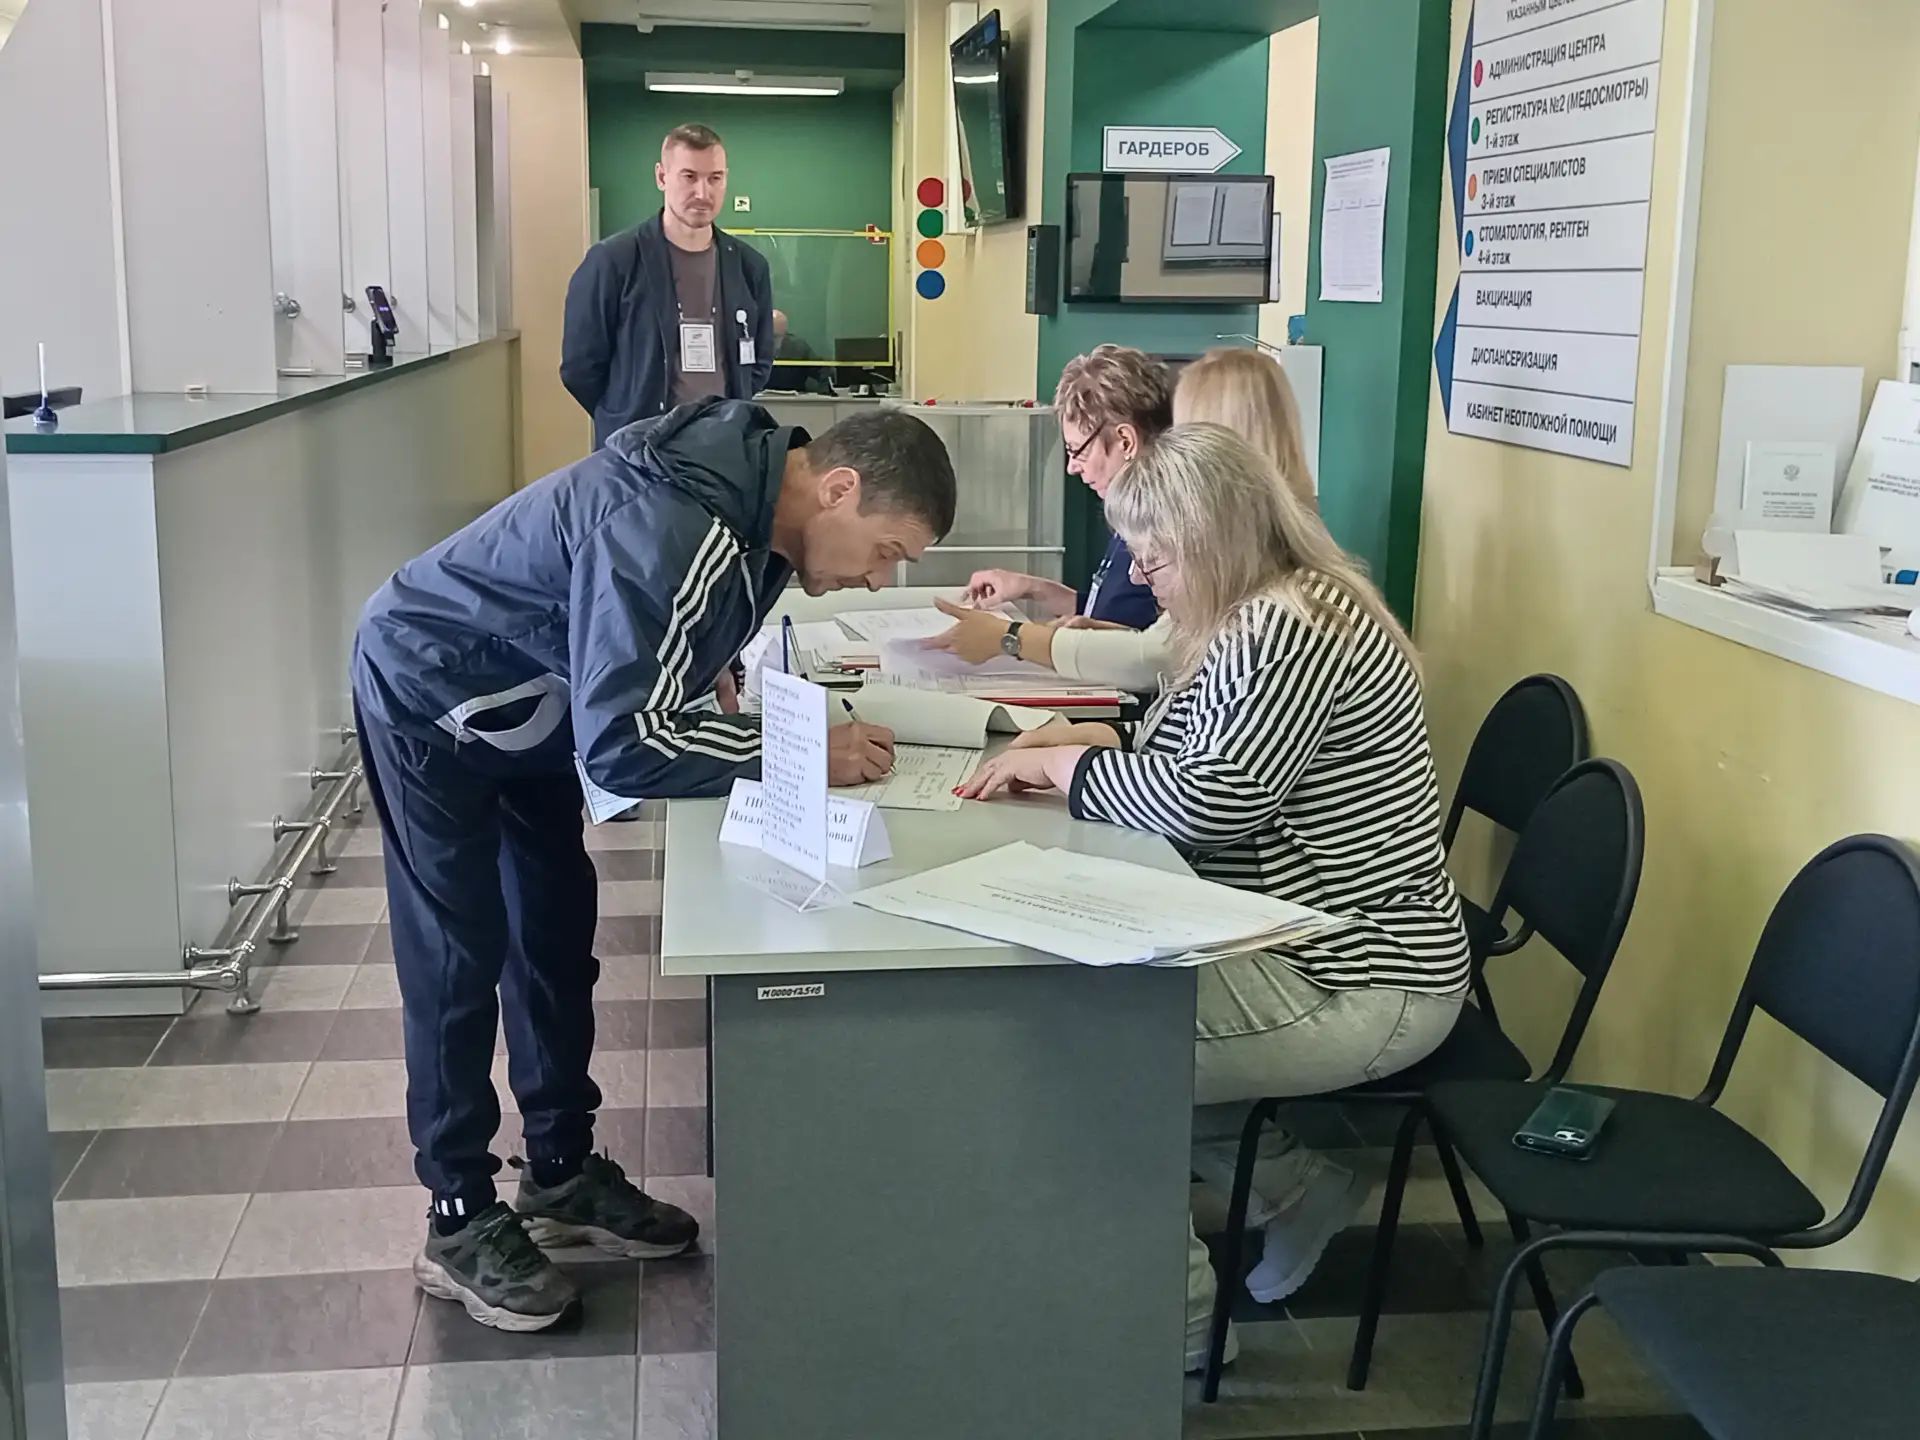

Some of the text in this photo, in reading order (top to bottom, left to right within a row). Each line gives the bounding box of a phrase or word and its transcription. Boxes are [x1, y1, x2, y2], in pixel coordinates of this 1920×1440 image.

[1489, 33, 1606, 79] АДМИНИСТРАЦИЯ ЦЕНТРА
[1485, 77, 1649, 126] РЕГИСТРАТУРА №2 (МЕДОСМОТРЫ)
[1119, 141, 1209, 157] ГАРДЕРОБ
[1485, 132, 1519, 149] 1-й этаж
[1482, 157, 1586, 186] ПРИЕМ СПЕЦИАЛИСТОВ
[1481, 193, 1516, 210] 3-й этаж
[1479, 220, 1590, 243] СТОМАТОЛОГИЯ, РЕНТГЕН
[1478, 249, 1511, 266] 4-й этаж
[1476, 289, 1532, 310] ВАКЦИНАЦИЯ
[1471, 346, 1558, 373] ДИСПАНСЕРИЗАЦИЯ
[1466, 402, 1618, 446] КАБИНЕТ НЕОТЛОЖНОЙ ПОМОЩИ
